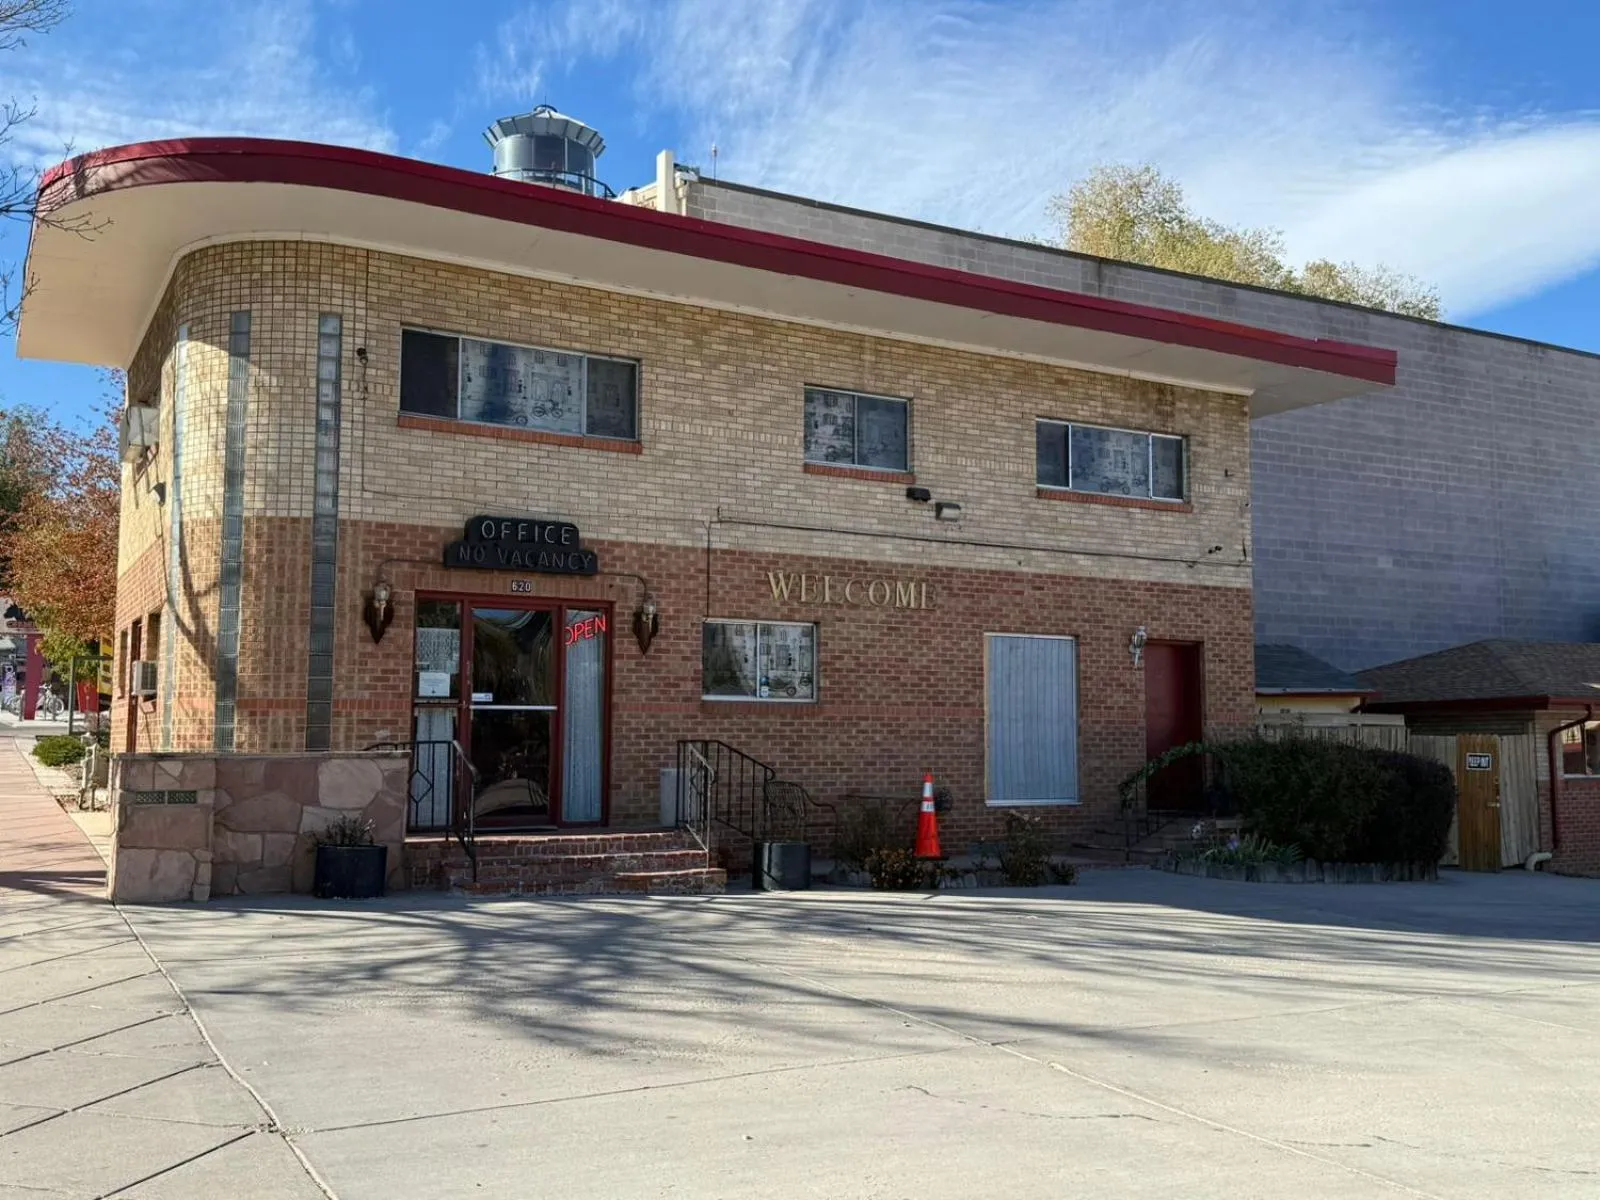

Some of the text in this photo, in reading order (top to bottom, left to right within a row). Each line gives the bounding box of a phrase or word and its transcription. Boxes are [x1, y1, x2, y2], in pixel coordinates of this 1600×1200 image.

[481, 520, 575, 545] OFFICE
[459, 545, 593, 570] NO VACANCY
[512, 581, 531, 592] 620
[767, 570, 937, 609] WELCOME
[564, 614, 606, 646] OPEN
